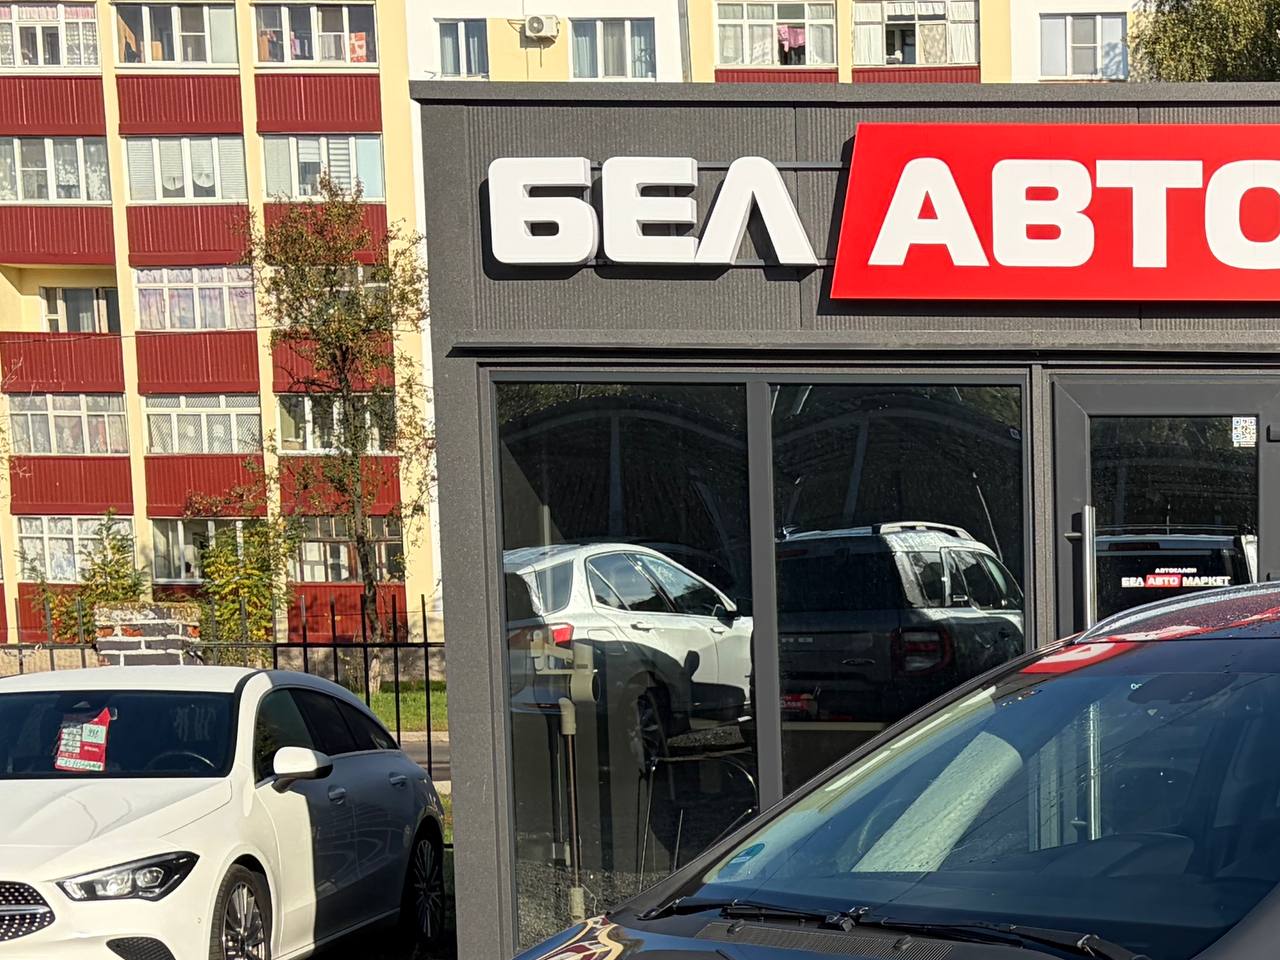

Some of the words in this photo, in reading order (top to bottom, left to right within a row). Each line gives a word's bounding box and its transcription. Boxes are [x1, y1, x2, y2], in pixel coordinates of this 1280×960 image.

[487, 156, 819, 266] БЕЛ
[1121, 577, 1145, 588] БЕЛ
[1147, 576, 1179, 587] АВТО
[1182, 576, 1231, 587] МАРКЕТ
